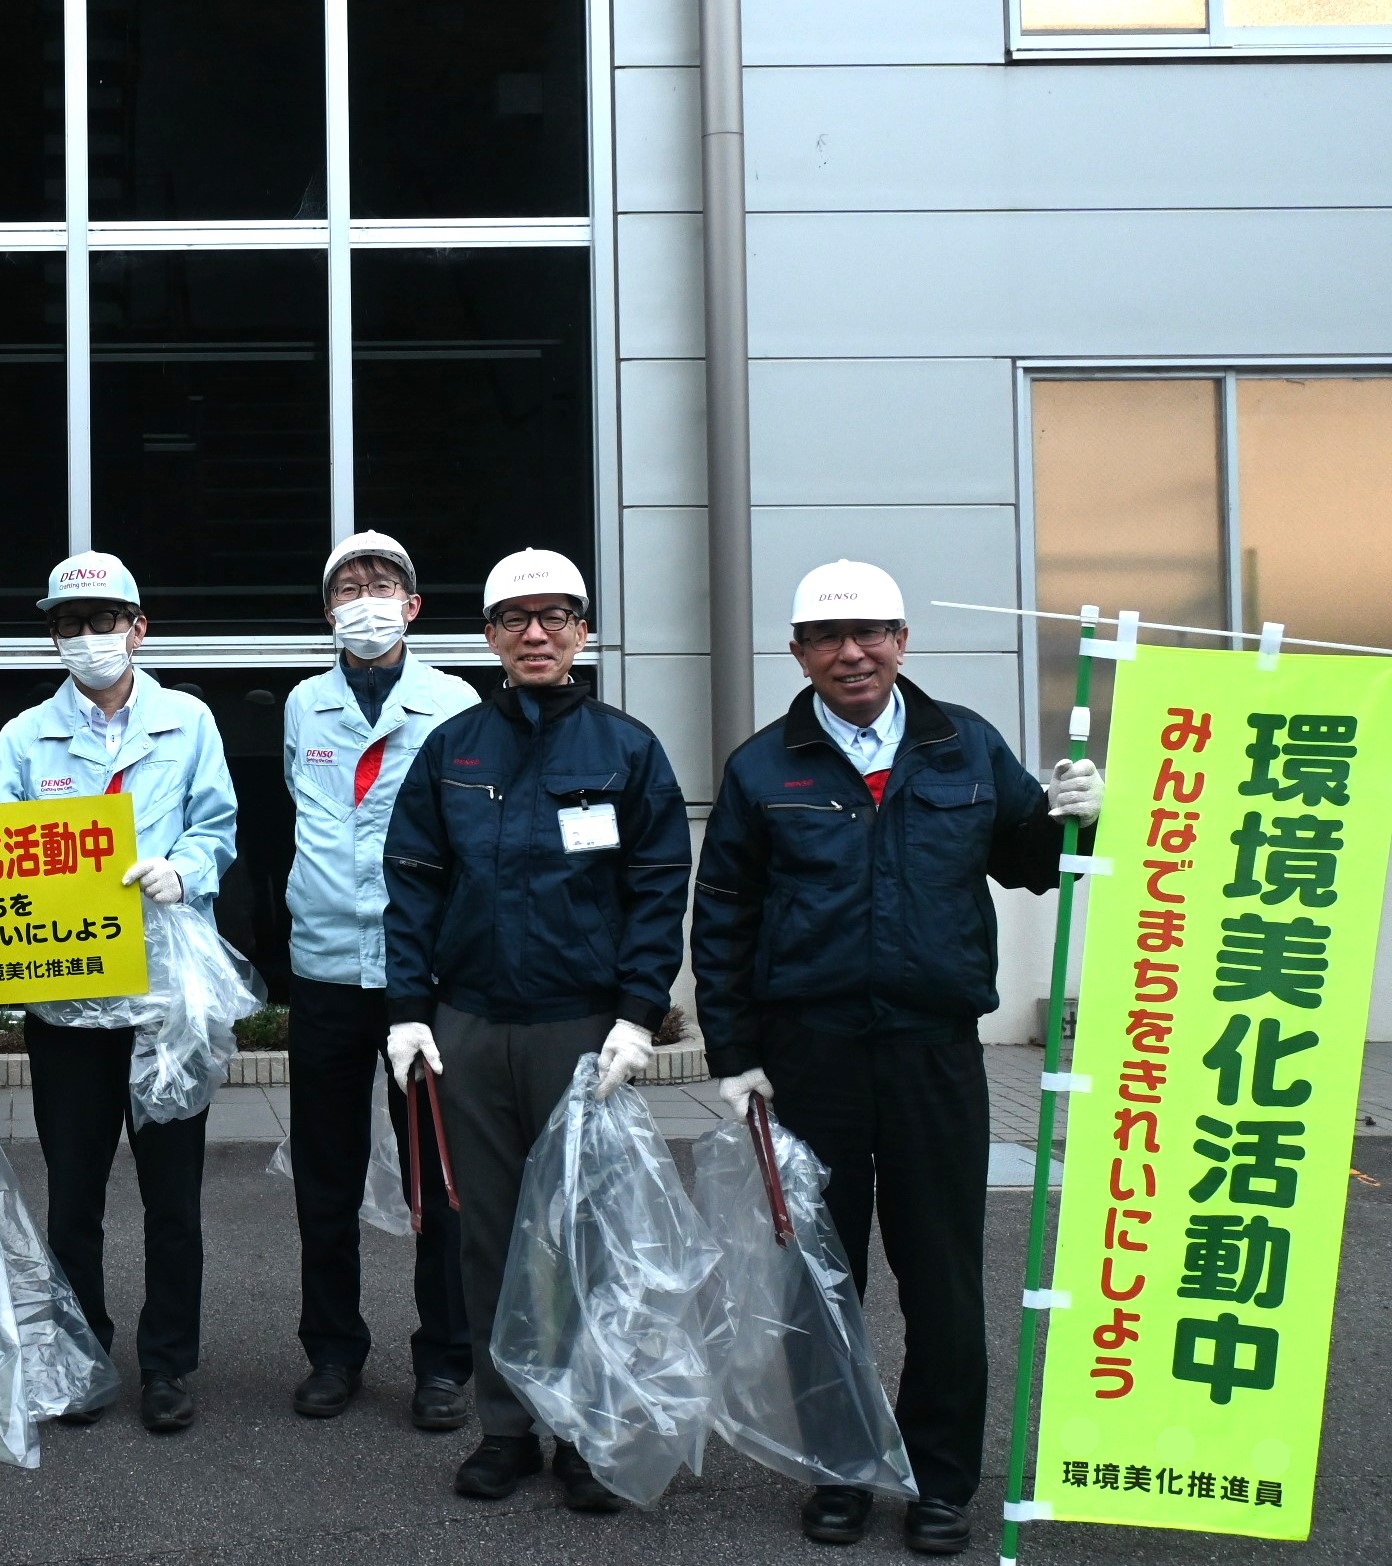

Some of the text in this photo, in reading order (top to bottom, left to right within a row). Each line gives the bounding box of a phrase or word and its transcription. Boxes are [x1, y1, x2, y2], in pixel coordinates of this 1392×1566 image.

[60, 569, 107, 582] DENSO
[514, 571, 549, 582] DENSO
[818, 592, 858, 602] DENSO
[306, 749, 333, 758] DENSO
[40, 777, 72, 787] DENSO
[1094, 709, 1212, 1398] みんなでまちをきれいにしよう
[1172, 712, 1358, 1405] 環境美化活動中
[1062, 1461, 1283, 1508] 環境美化推進員
